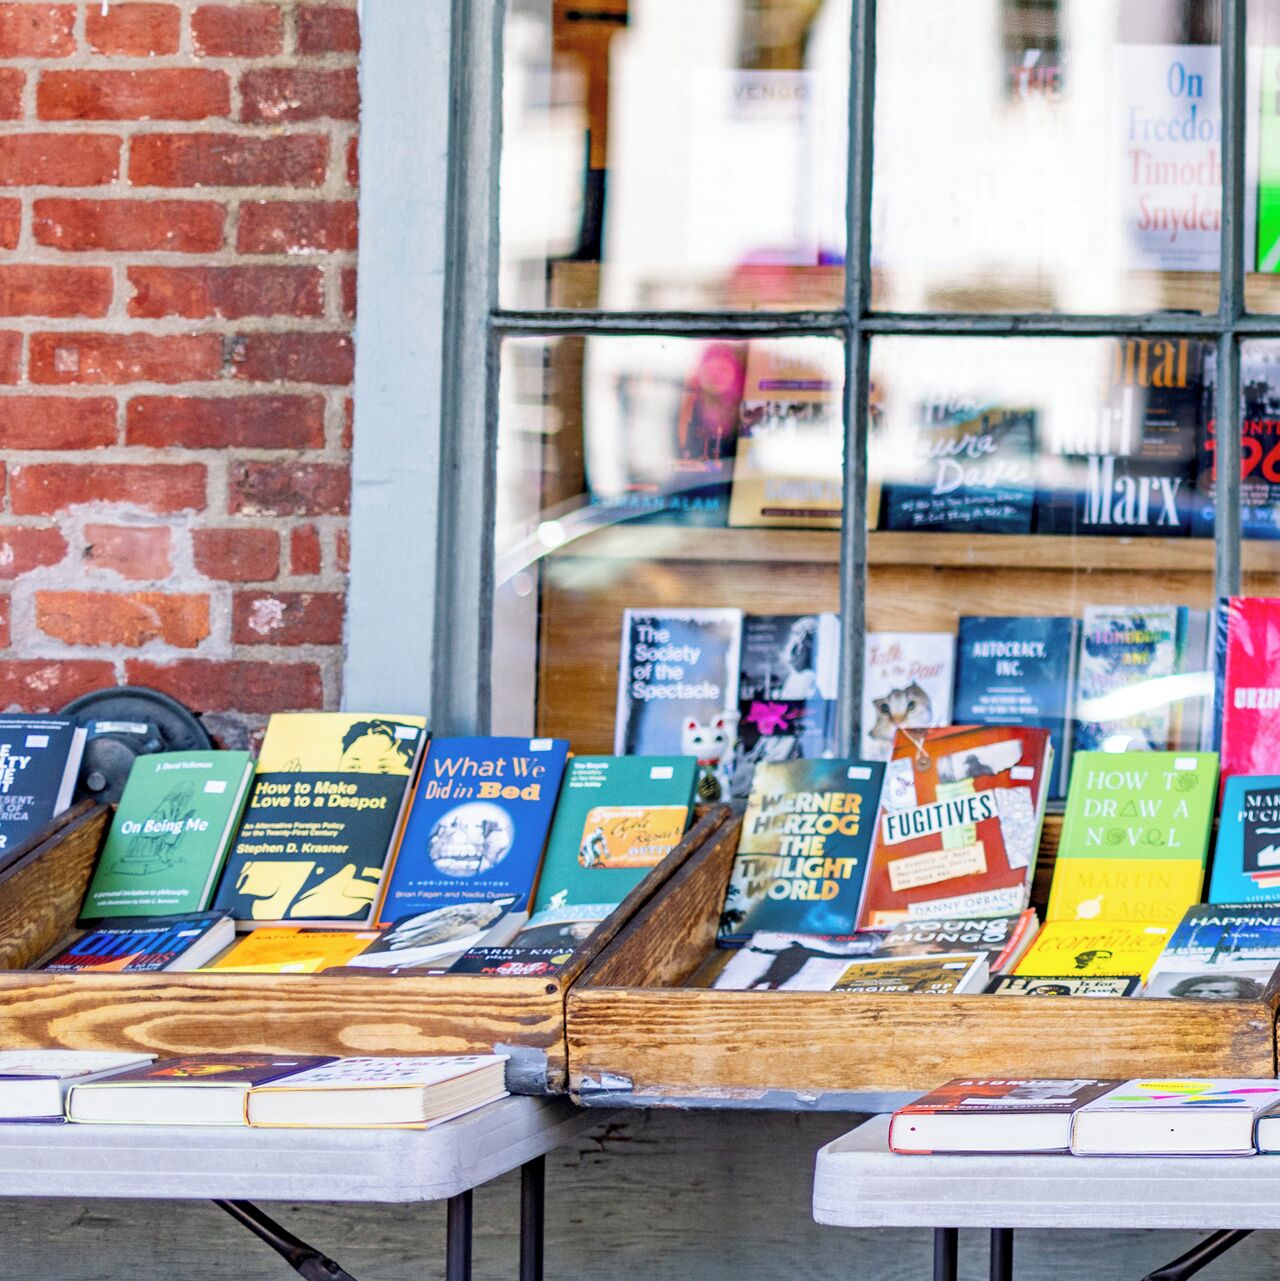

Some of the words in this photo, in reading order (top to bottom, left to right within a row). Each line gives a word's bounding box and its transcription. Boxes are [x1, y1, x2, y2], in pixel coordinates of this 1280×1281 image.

[1167, 62, 1203, 99] On
[1081, 456, 1183, 526] Marx
[637, 624, 671, 643] The
[633, 644, 702, 665] Society
[632, 663, 653, 681] of
[654, 664, 684, 681] the
[995, 660, 1024, 677] INC.
[631, 681, 721, 703] Spectacle
[433, 757, 507, 778] What
[512, 756, 547, 780] We
[255, 782, 291, 795] How
[294, 783, 311, 795] to
[314, 783, 358, 795] Make
[425, 780, 454, 800] Did
[454, 784, 473, 799] in
[476, 781, 542, 802] Bed
[1086, 771, 1148, 791] HOW
[251, 795, 290, 809] Love
[293, 796, 310, 808] to
[313, 798, 323, 808] a
[327, 796, 387, 812] Despot
[760, 792, 862, 815] WERNER
[1083, 799, 1162, 819] DRAW
[1173, 799, 1190, 818] A
[752, 814, 861, 836] HERZOG
[886, 793, 993, 841] FUGITIVES
[120, 820, 141, 834] On
[144, 819, 184, 836] Being
[187, 819, 209, 832] Me
[236, 842, 285, 855] Stephen
[286, 843, 299, 853] D.
[301, 843, 350, 854] Krasner
[779, 835, 827, 856] THE
[740, 857, 858, 880] TWILIGHT
[746, 879, 840, 901] WORLD
[901, 918, 1009, 933] YOUNG
[888, 932, 1008, 944] MUNGO
[1073, 986, 1121, 995] Hawk
